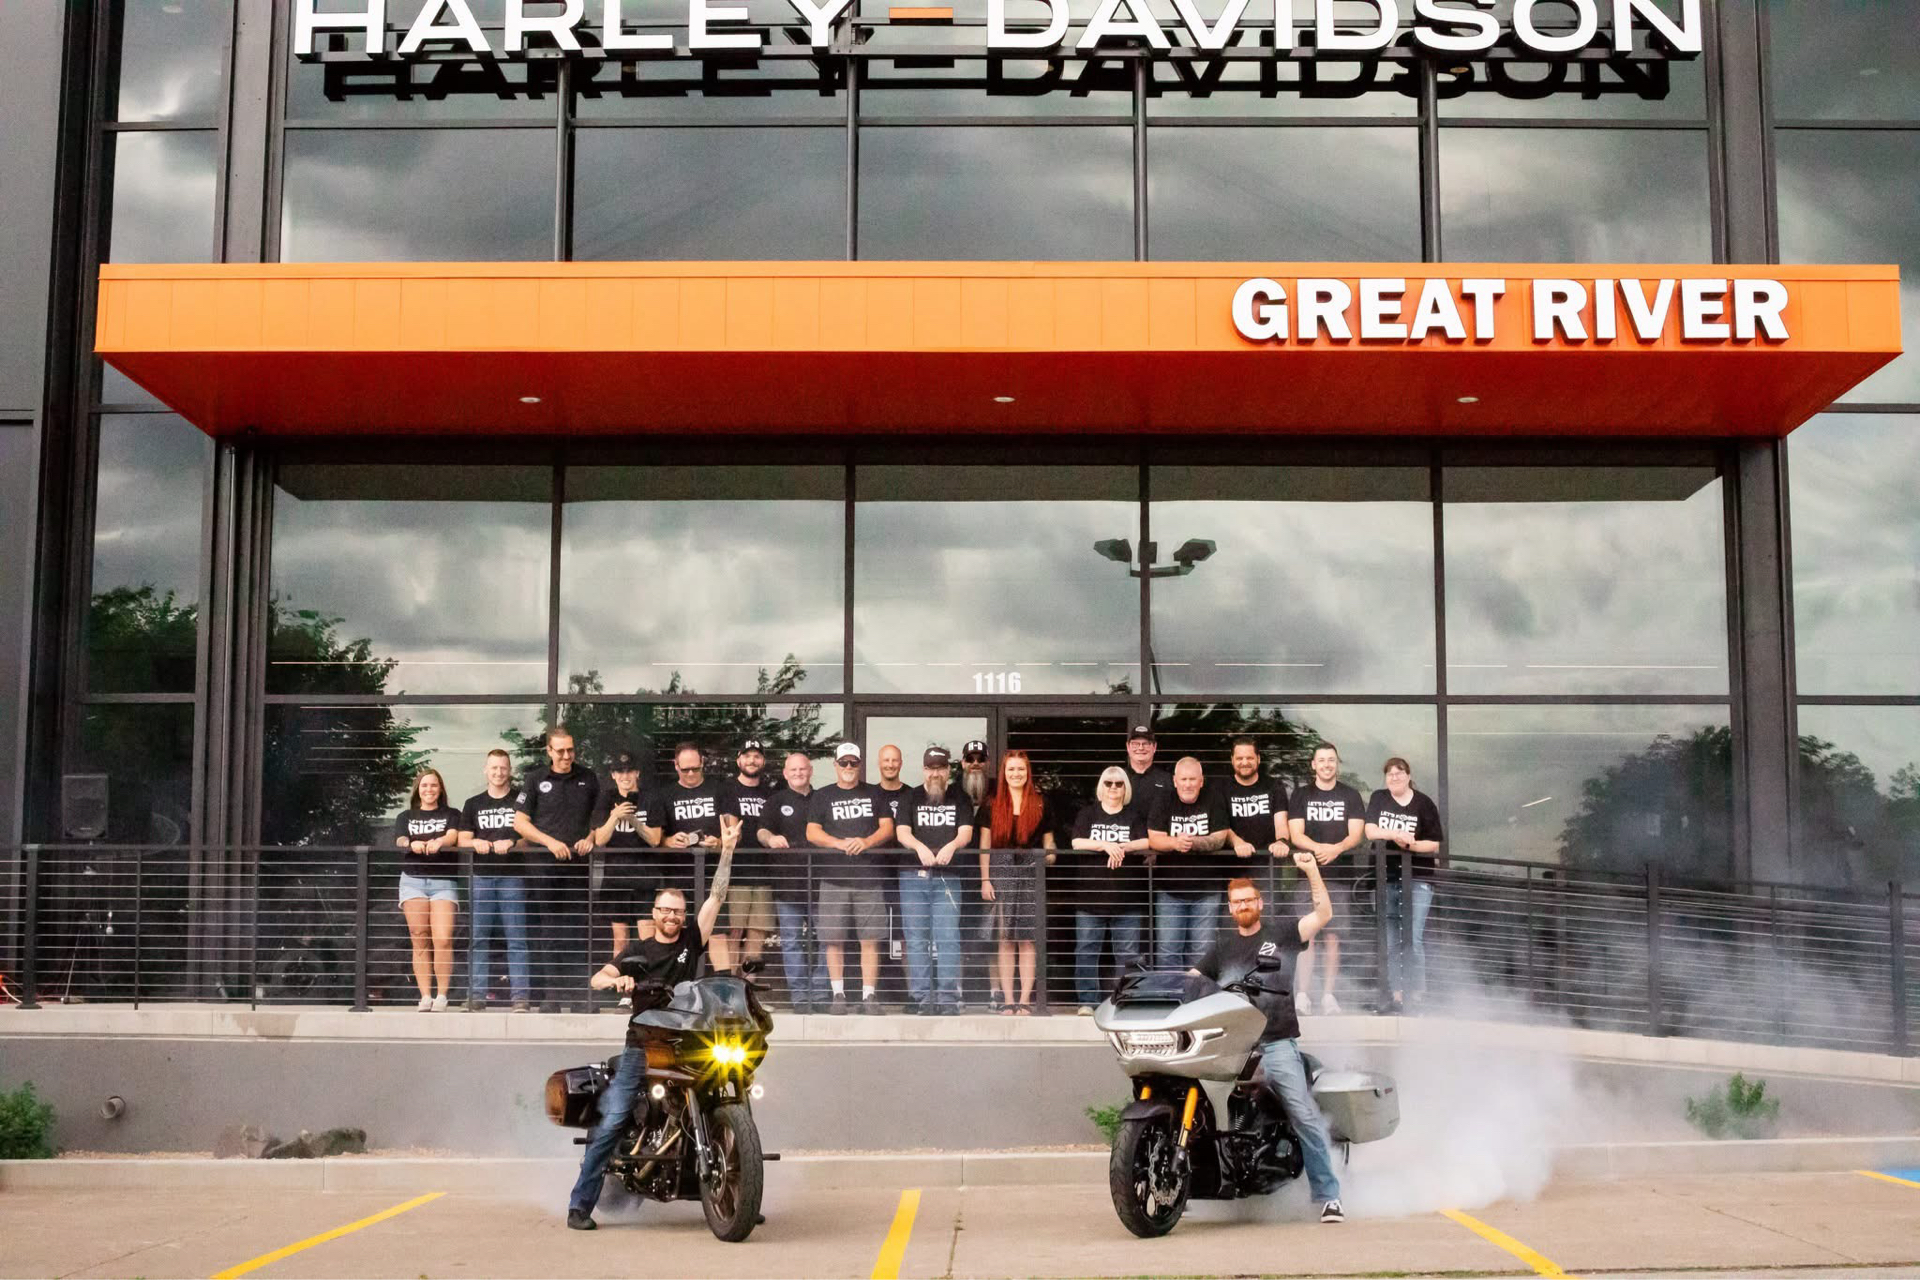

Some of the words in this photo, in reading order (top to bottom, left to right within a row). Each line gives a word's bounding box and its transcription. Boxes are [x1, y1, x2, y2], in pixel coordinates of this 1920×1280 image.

[1232, 278, 1506, 342] GREAT
[1532, 278, 1790, 342] RIVER
[972, 672, 1021, 694] 1116
[674, 802, 716, 820] RIDE
[832, 804, 874, 820] RIDE
[1231, 800, 1270, 817] RIDE
[1307, 806, 1345, 821] RIDE
[478, 813, 516, 829] RIDE
[917, 811, 956, 826] RIDE
[1378, 816, 1418, 835] RIDE
[408, 823, 446, 835] RIDE
[1089, 829, 1131, 842] RIDE
[1170, 819, 1209, 837] RIDE
